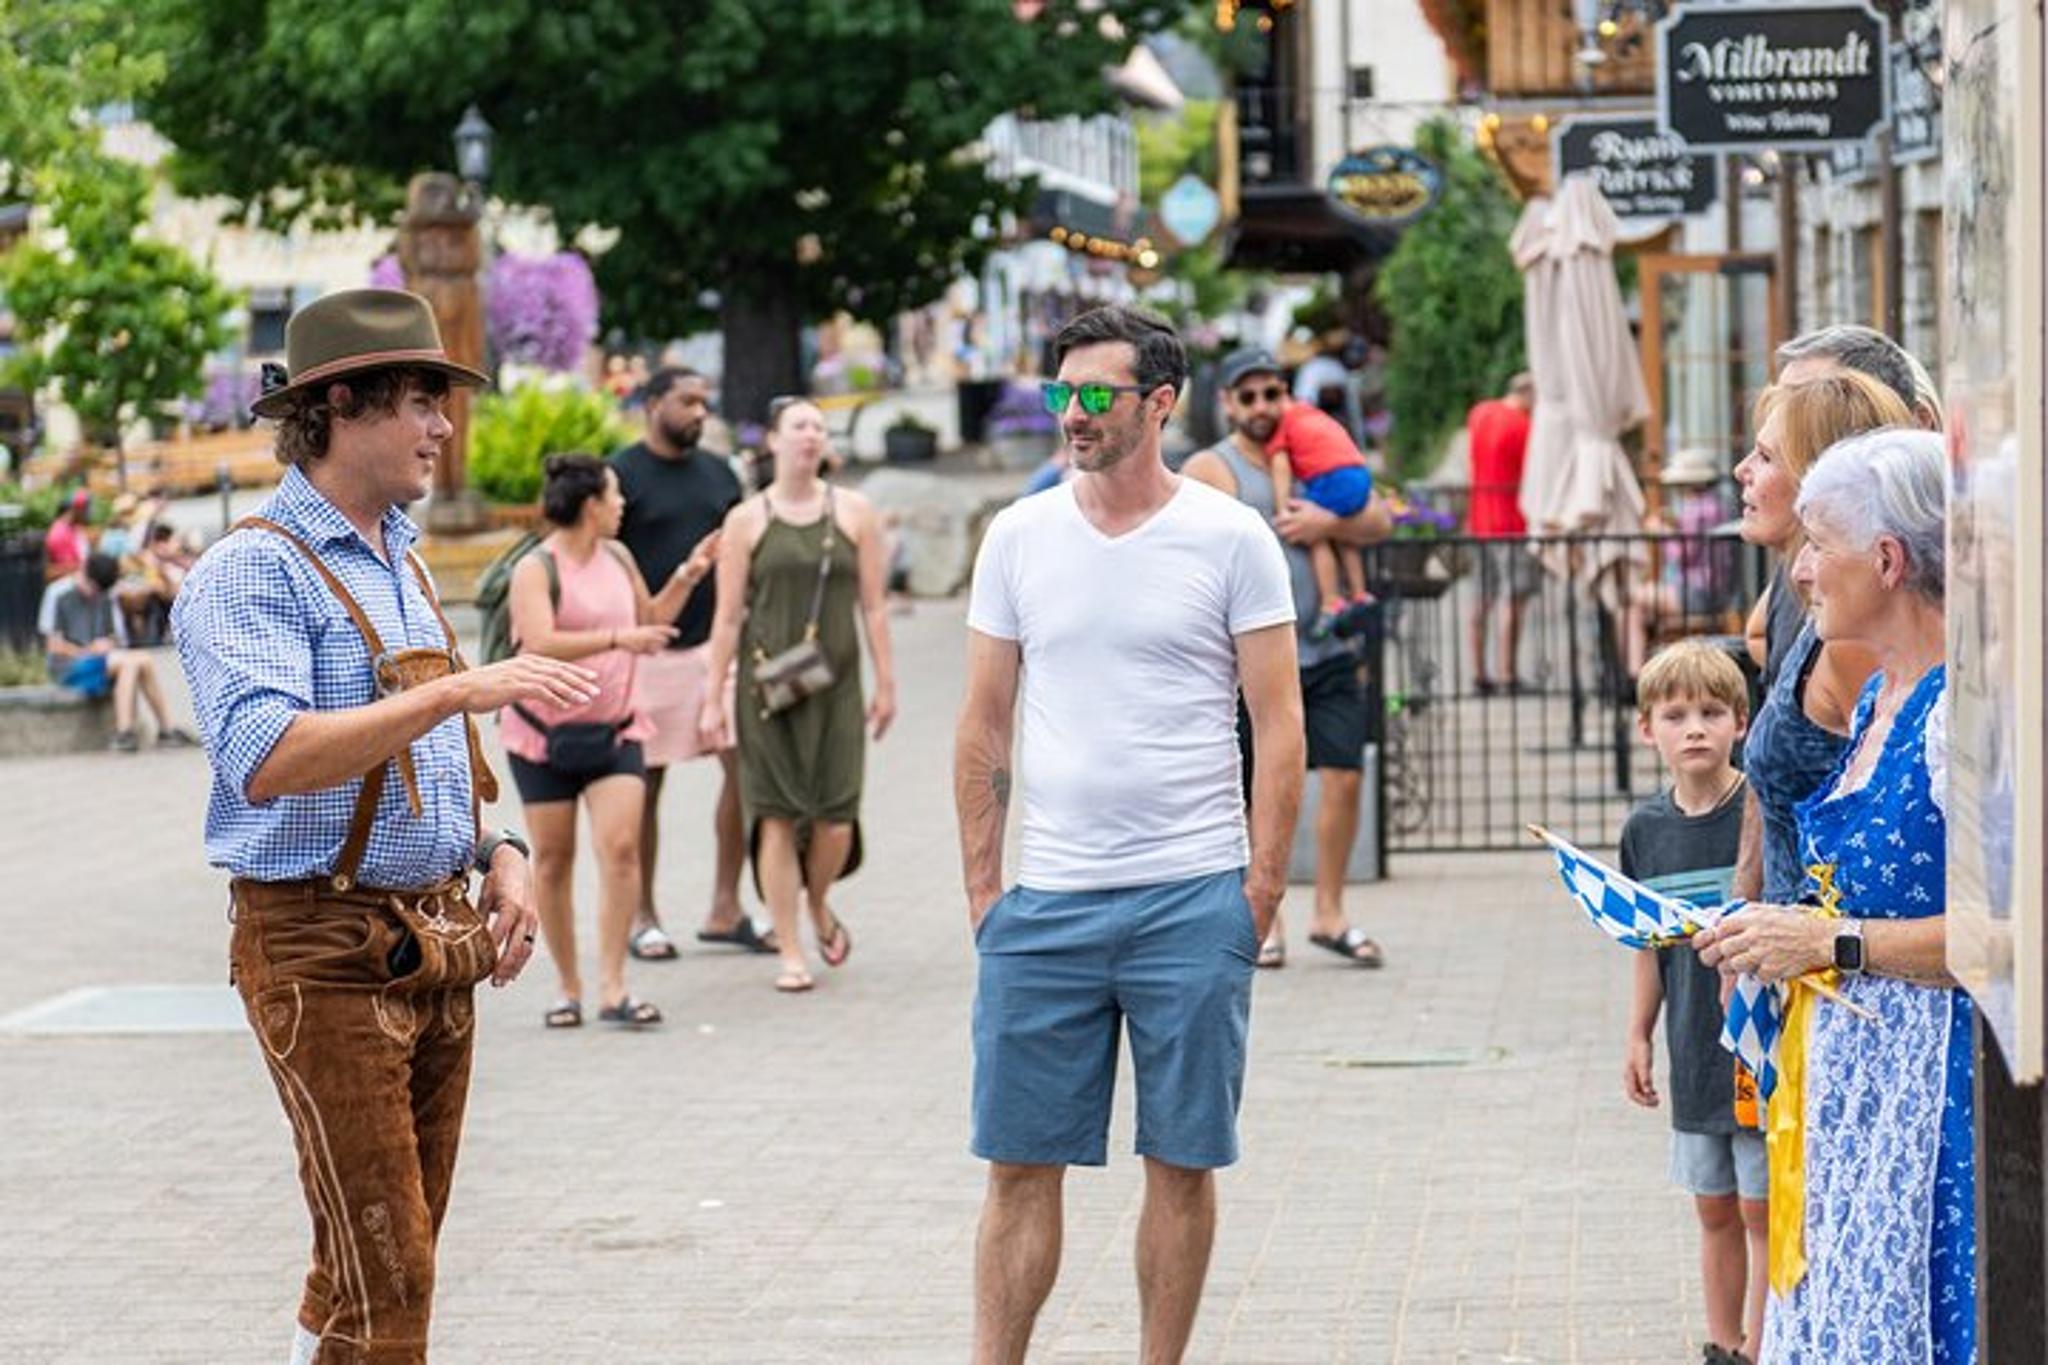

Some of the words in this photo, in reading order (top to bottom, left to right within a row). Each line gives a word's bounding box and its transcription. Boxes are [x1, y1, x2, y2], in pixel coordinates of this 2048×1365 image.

[1676, 31, 1870, 81] Milbrandt
[1708, 80, 1838, 102] VINEYARDS
[1724, 113, 1767, 132] Wine
